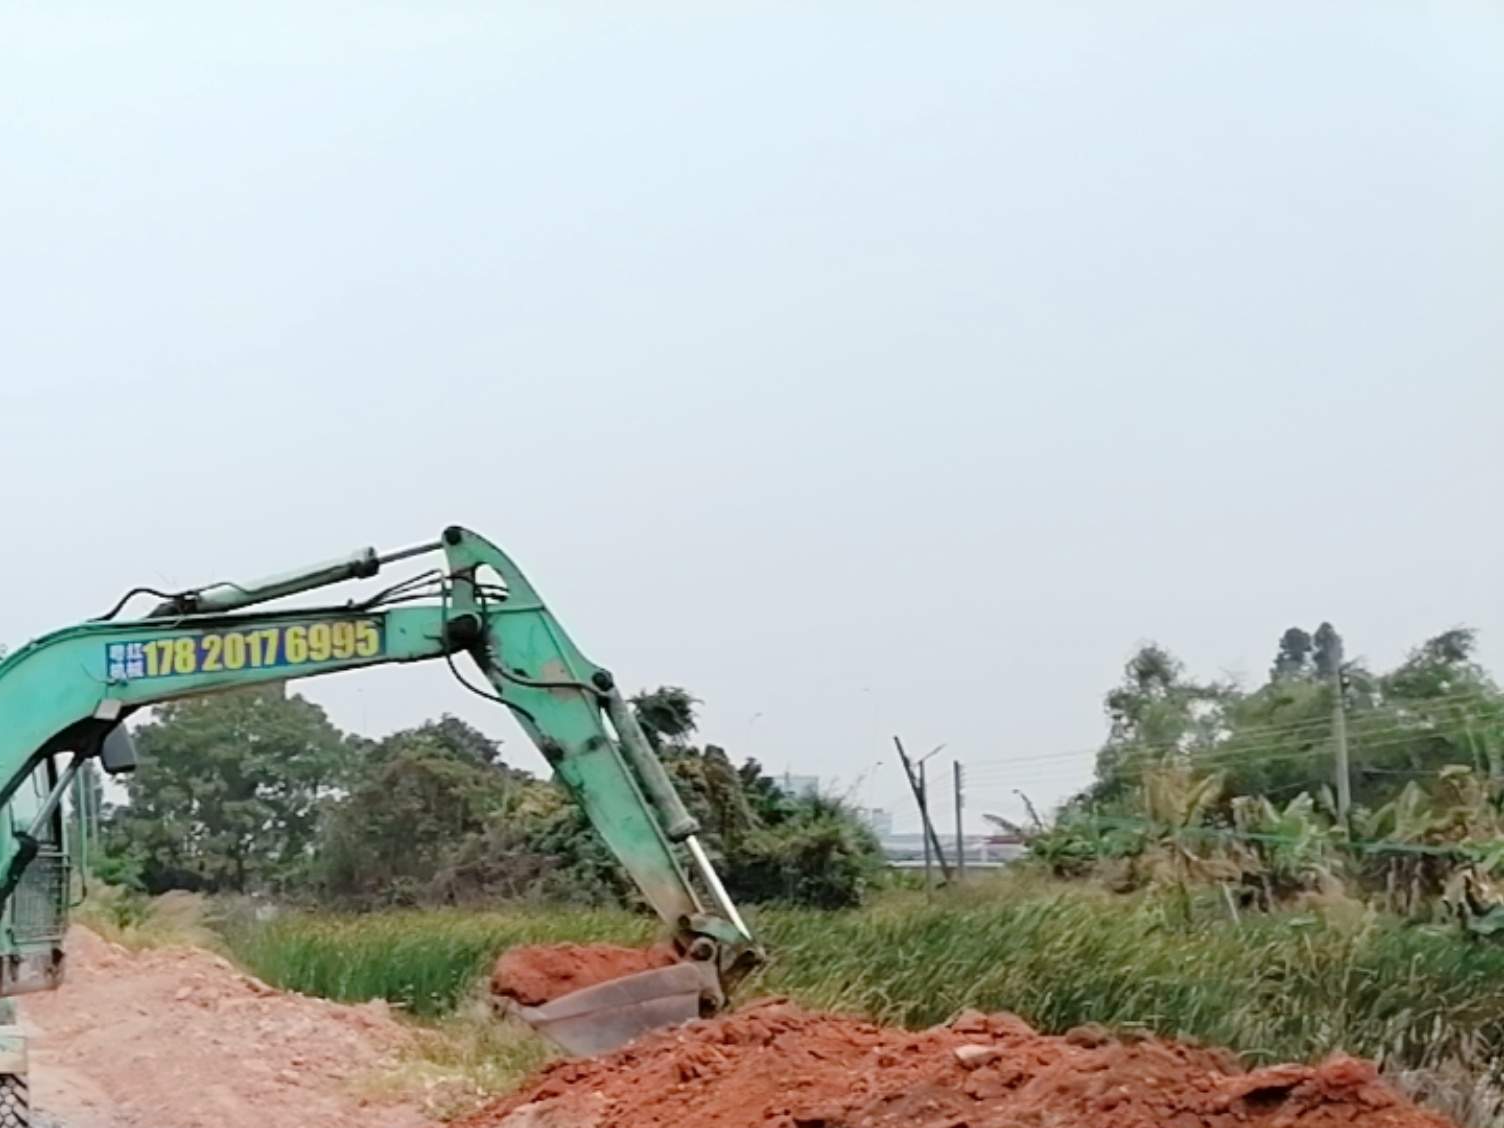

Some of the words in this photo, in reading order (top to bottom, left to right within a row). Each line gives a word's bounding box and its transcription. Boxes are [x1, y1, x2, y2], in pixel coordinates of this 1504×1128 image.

[143, 637, 197, 677] 178
[201, 628, 280, 672] 2017
[285, 619, 379, 663] 6995
